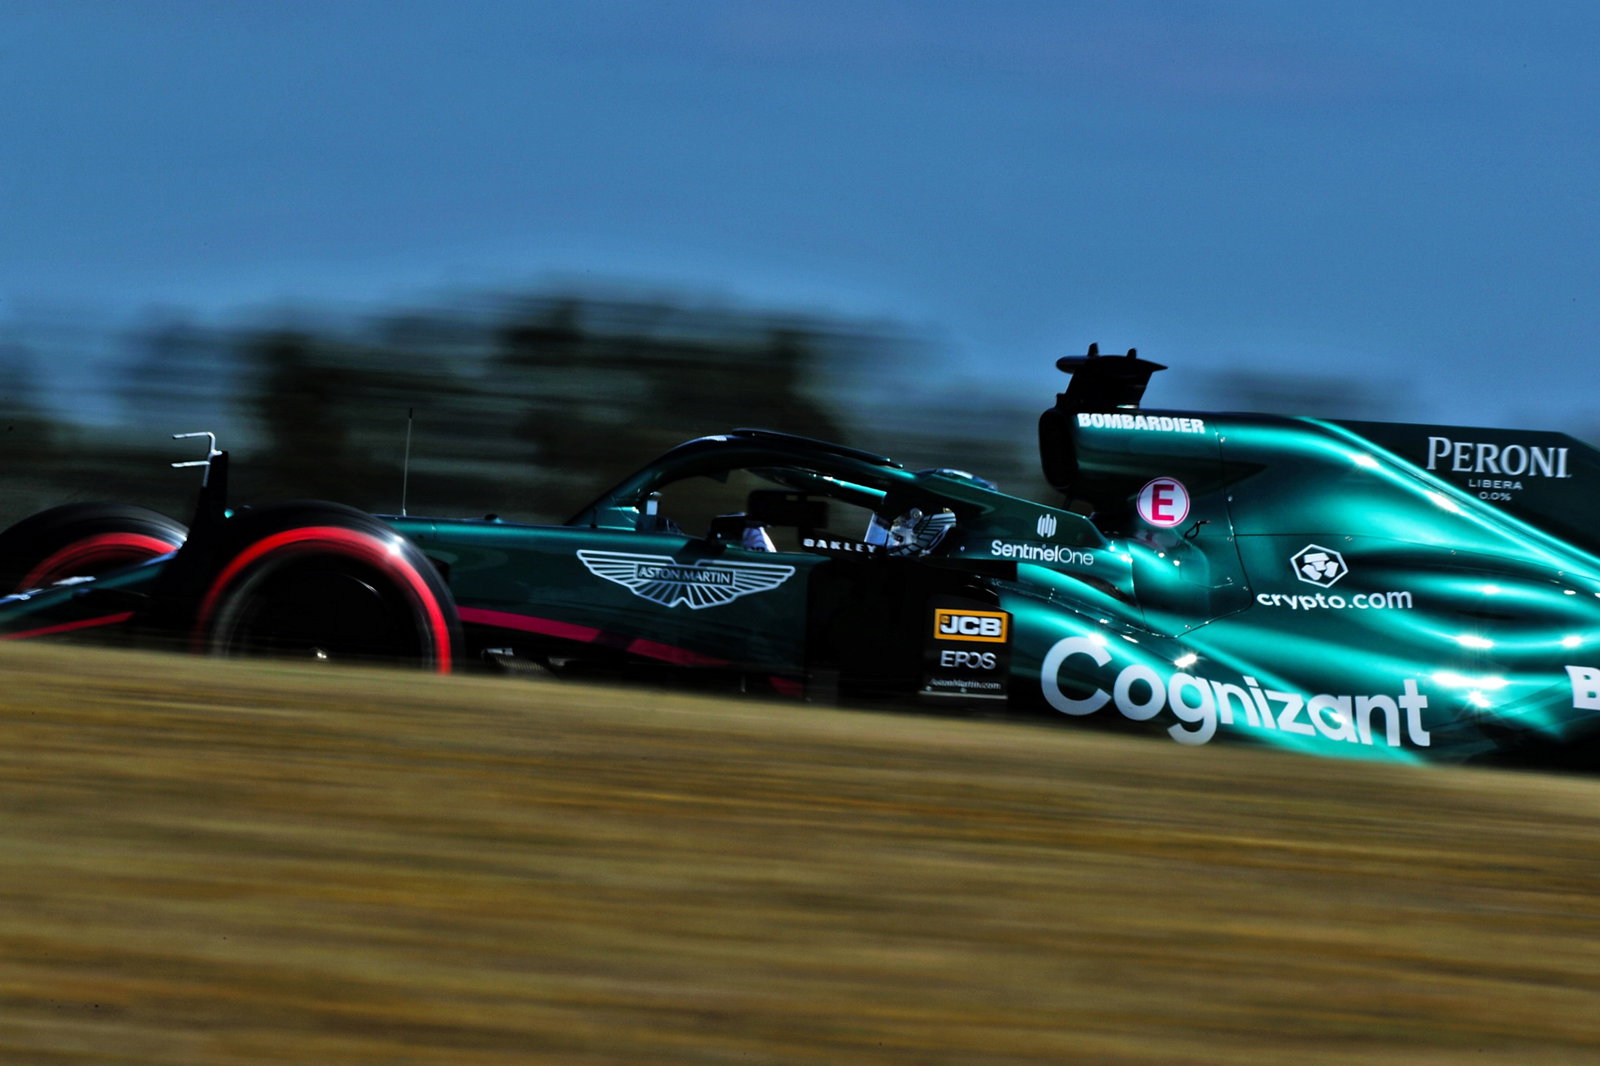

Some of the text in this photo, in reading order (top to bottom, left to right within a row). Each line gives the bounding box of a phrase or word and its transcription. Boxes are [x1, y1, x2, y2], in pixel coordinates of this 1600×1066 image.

[1077, 413, 1205, 434] BOMBARDIER
[1426, 436, 1570, 478] PERONI
[1468, 479, 1523, 490] LIBERA
[1151, 484, 1175, 521] E
[1478, 491, 1512, 501] 0.0%
[803, 538, 876, 553] OAKLEY
[991, 539, 1094, 566] SentinelOne
[638, 566, 730, 584] ASTON MARTIN
[1256, 591, 1413, 611] crypto.com
[940, 615, 1002, 637] JCB
[940, 650, 997, 670] EPOS
[1040, 636, 1431, 746] Cognizant
